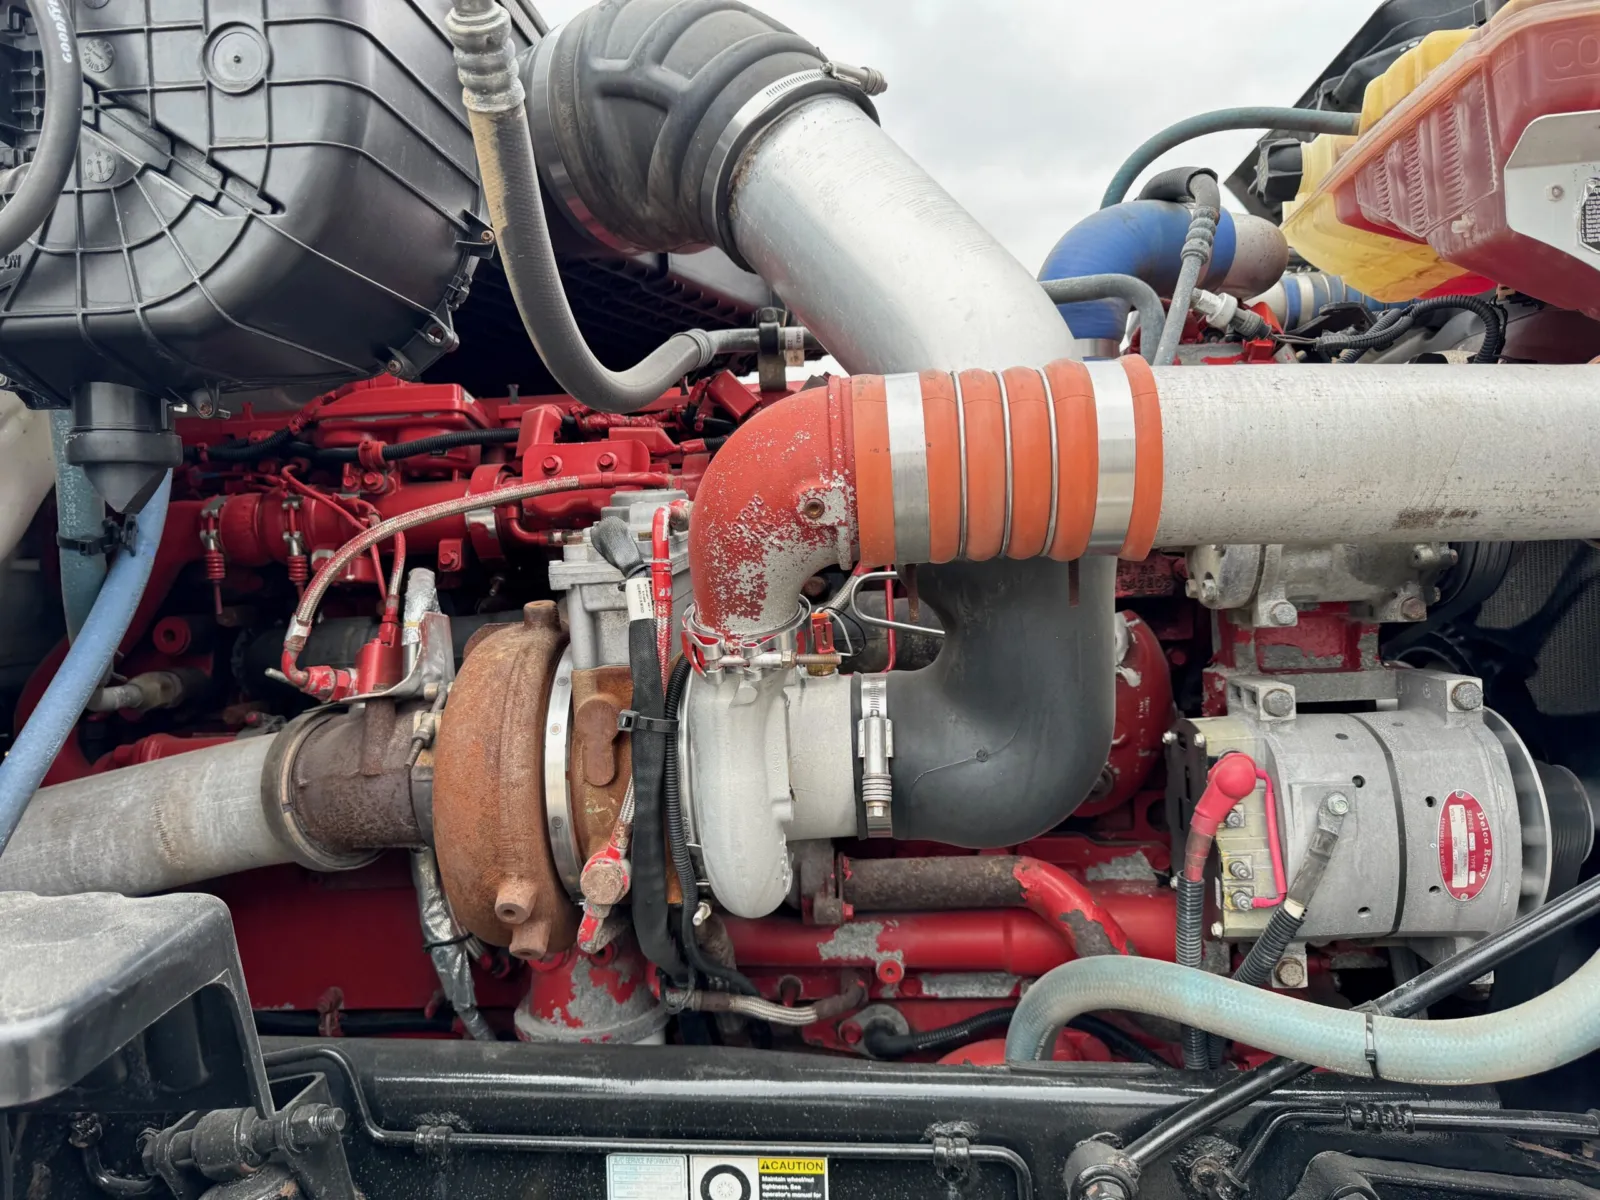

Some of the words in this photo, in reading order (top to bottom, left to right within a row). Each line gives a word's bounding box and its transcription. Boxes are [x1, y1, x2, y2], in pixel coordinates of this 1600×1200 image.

[1476, 812, 1489, 845] Delco
[1479, 848, 1492, 880] Remy
[770, 1161, 824, 1172] CAUTION
